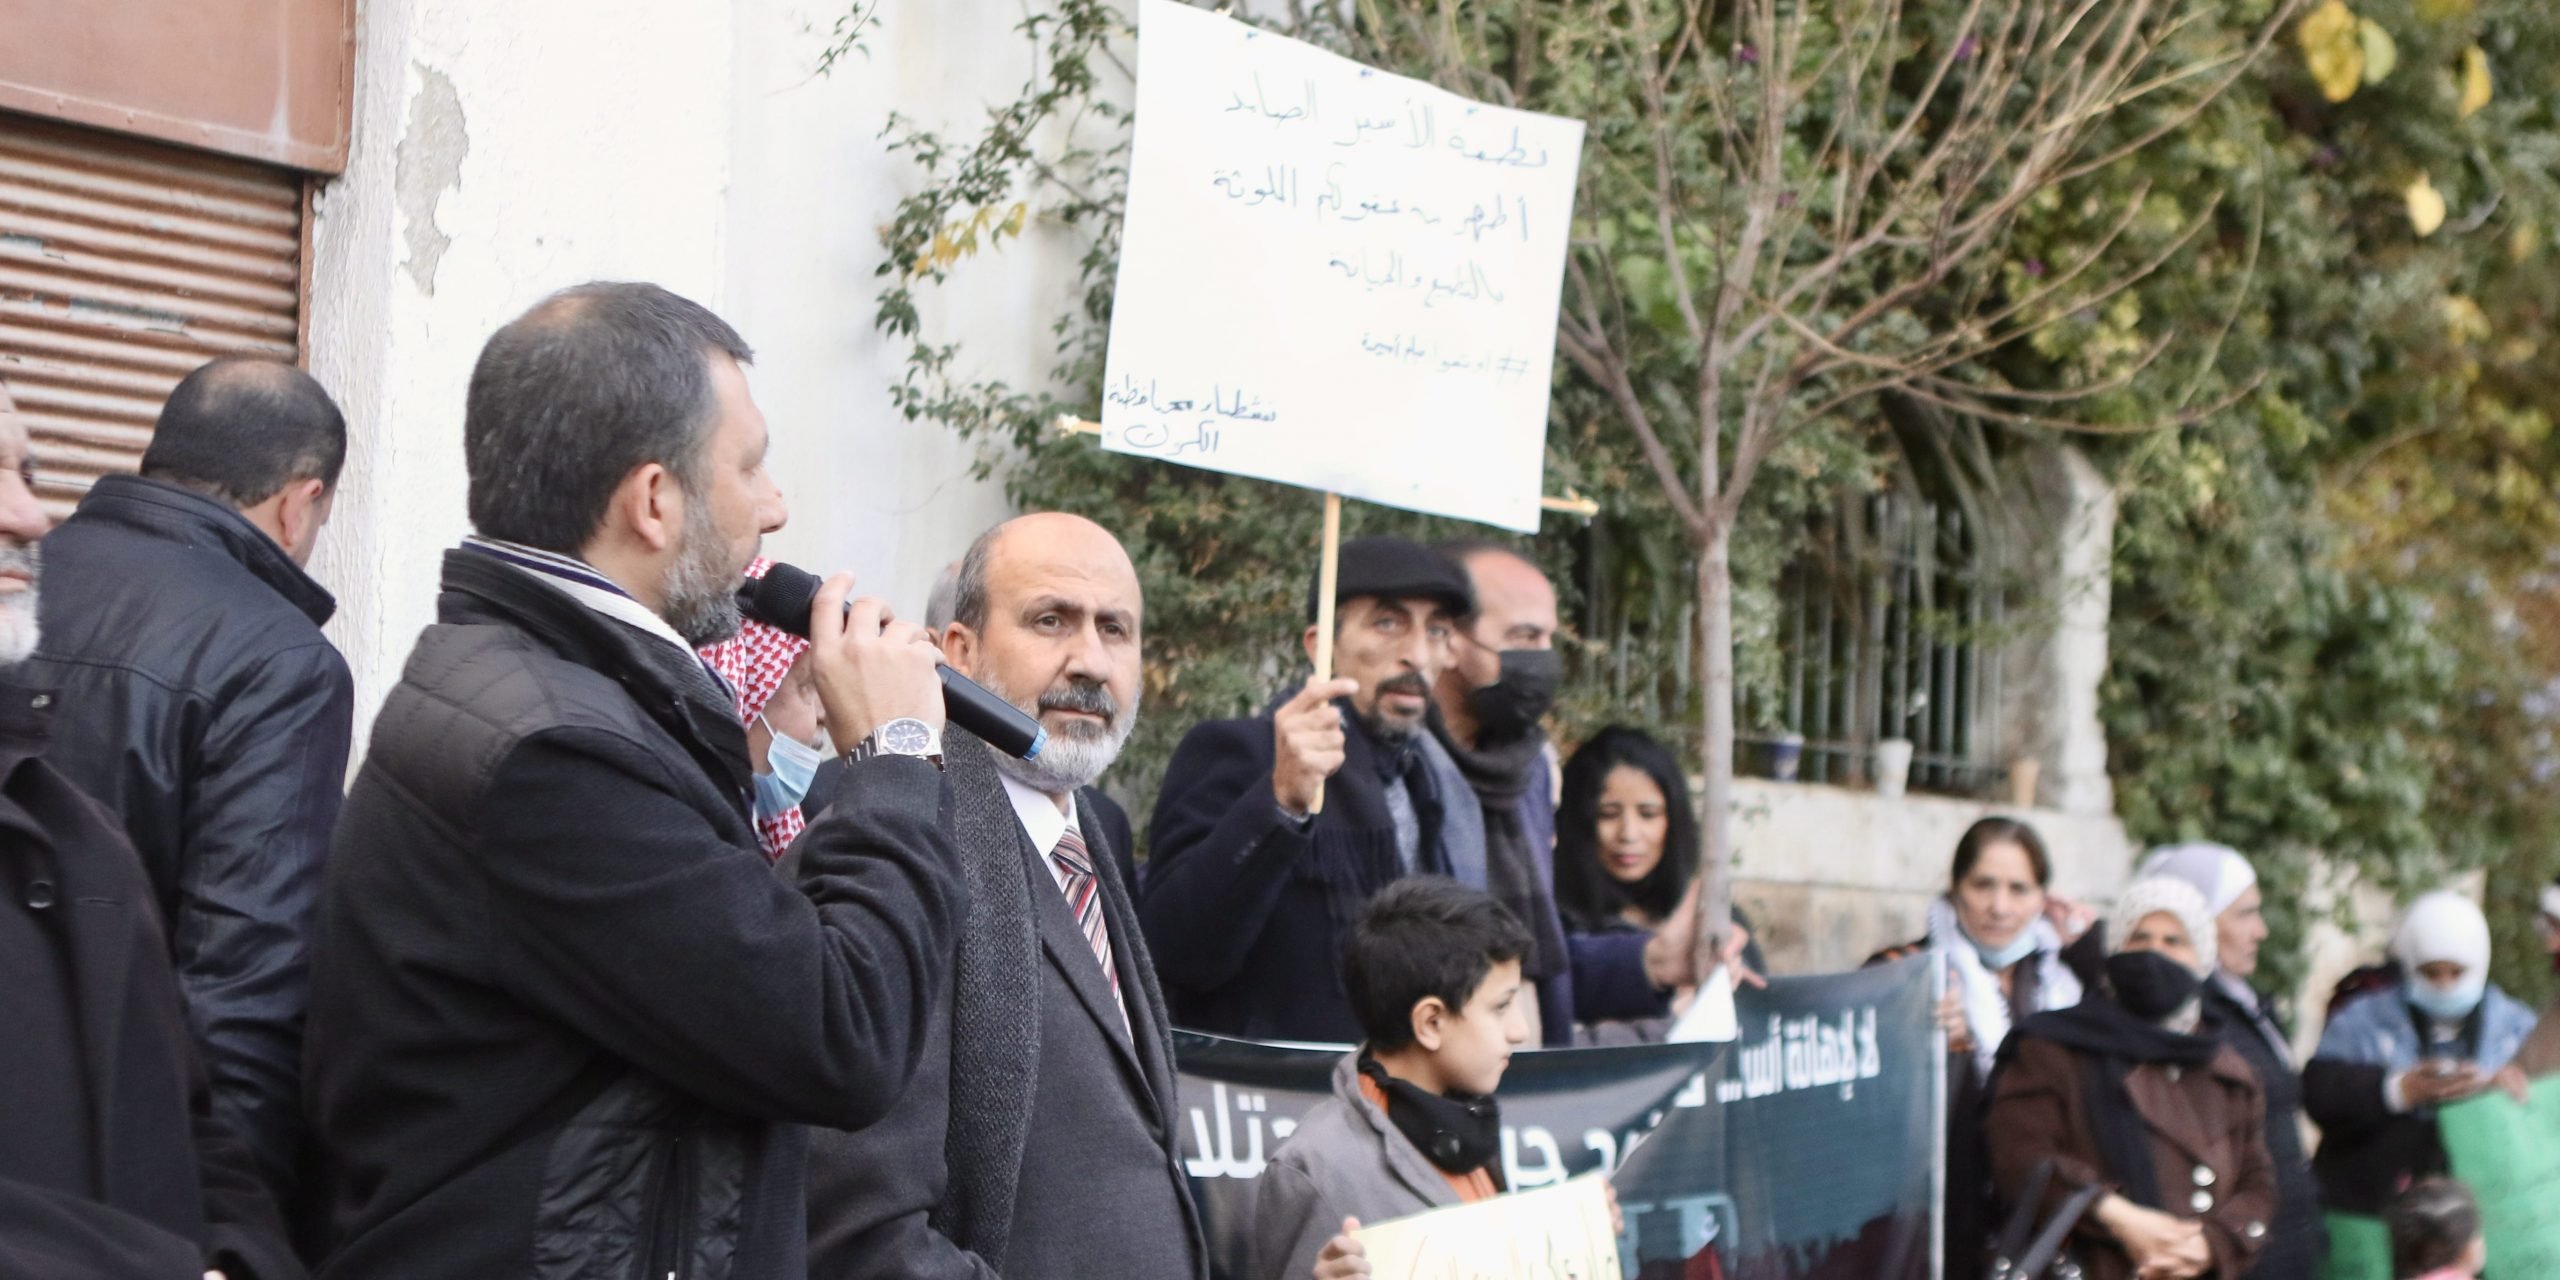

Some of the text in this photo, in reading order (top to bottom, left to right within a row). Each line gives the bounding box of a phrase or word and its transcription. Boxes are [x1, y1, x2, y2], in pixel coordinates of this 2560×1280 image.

[1332, 98, 1436, 148] الأسير
[1450, 192, 1530, 242] أطهر
[1108, 373, 1194, 414] محافظة
[1123, 420, 1220, 456] الكرك
